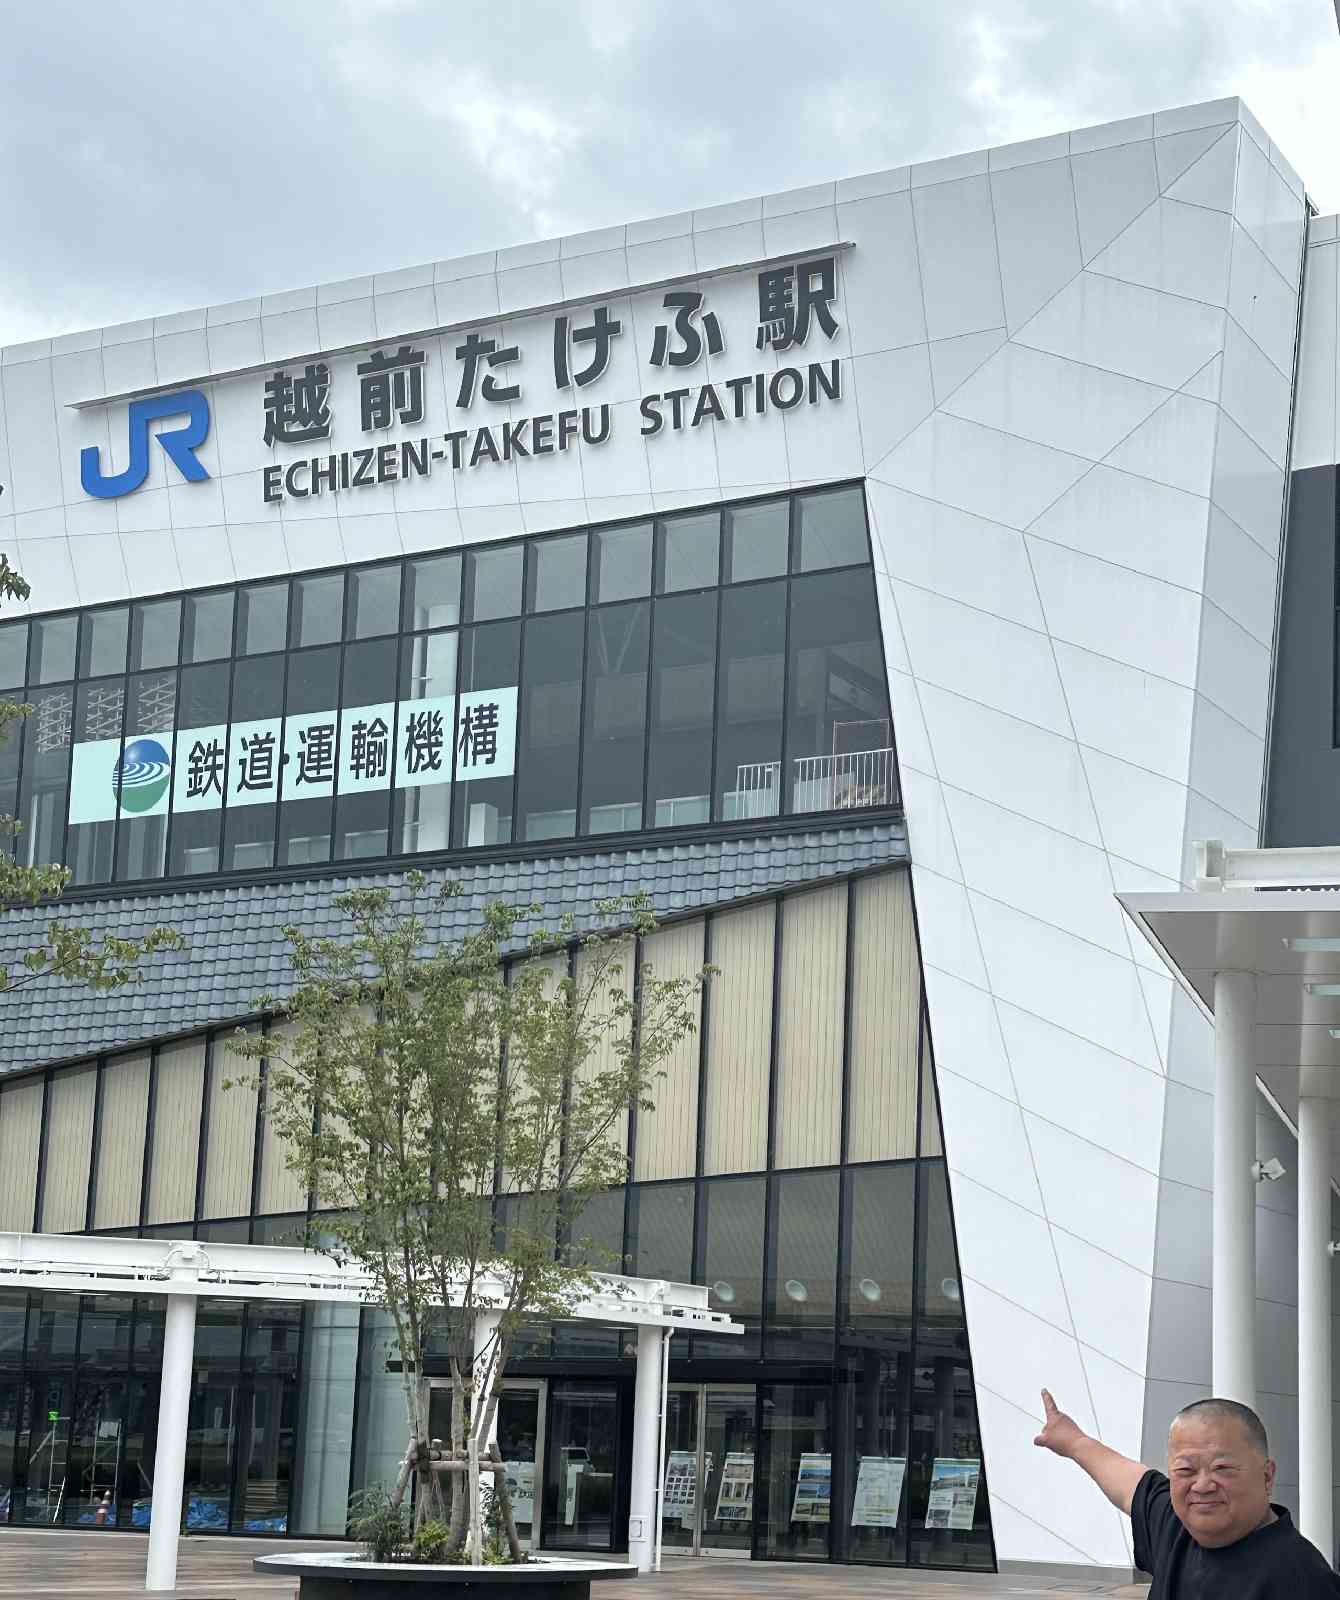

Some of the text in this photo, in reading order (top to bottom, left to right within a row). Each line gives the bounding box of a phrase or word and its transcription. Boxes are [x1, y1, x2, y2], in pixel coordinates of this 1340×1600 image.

[262, 257, 841, 447] 越前たけふ駅
[80, 389, 211, 499] JR
[263, 358, 842, 502] ECHIZEN-TAKEFU STATION
